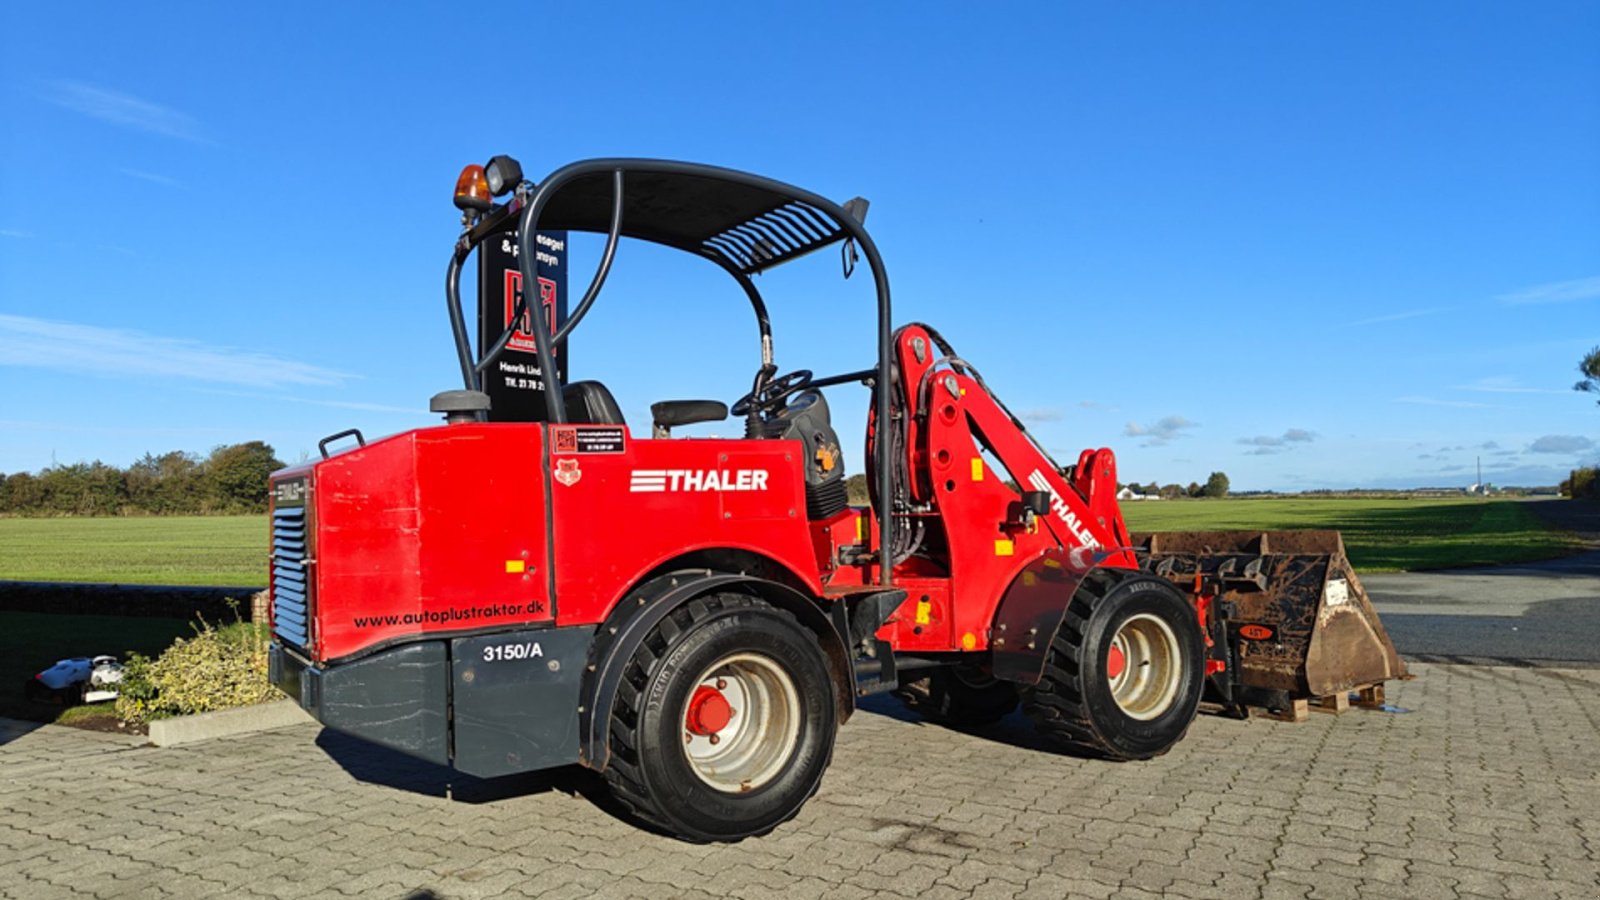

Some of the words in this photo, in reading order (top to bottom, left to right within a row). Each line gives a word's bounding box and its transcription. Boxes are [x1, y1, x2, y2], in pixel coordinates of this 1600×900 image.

[502, 239, 511, 253] &
[500, 361, 525, 374] Henrik
[667, 469, 769, 492] THALER
[354, 600, 545, 628] www.autoplustraktor.dk
[483, 642, 544, 662] 3150/A
